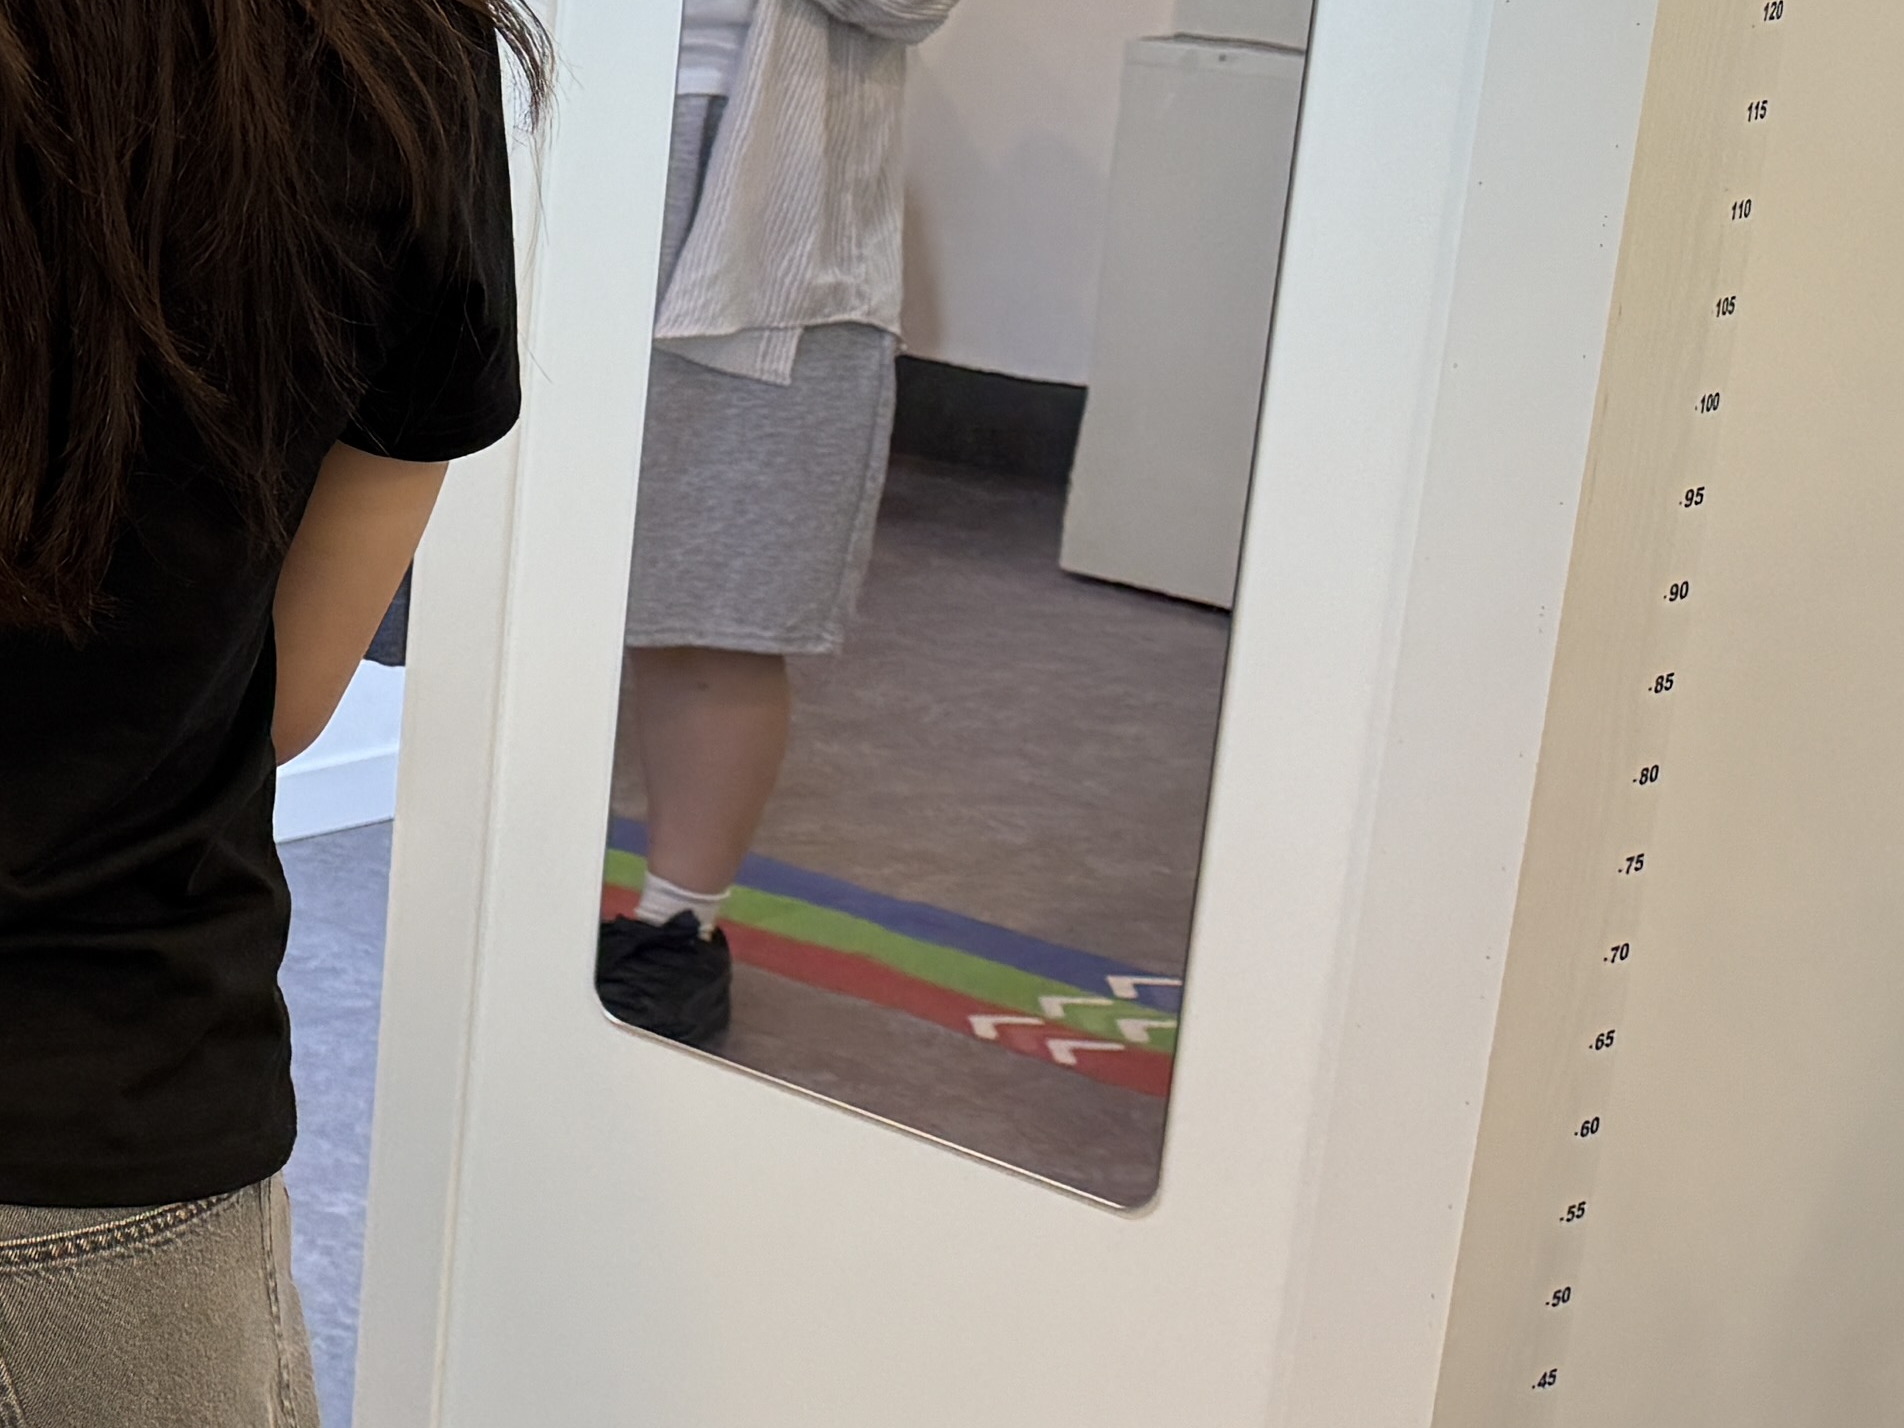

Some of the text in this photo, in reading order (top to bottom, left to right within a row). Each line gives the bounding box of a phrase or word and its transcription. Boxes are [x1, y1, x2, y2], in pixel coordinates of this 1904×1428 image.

[1763, 0, 1784, 22] 120
[1747, 99, 1769, 123] 115
[1731, 198, 1752, 221] 110
[1715, 295, 1737, 318] 105
[1700, 391, 1721, 414] 100
[1684, 485, 1706, 509] 95
[1669, 580, 1690, 603] 90
[1653, 671, 1675, 694] 85
[1638, 764, 1660, 786] 80
[1623, 852, 1645, 876] 75
[1609, 942, 1630, 964] 70
[1594, 1029, 1616, 1051] 65
[1579, 1116, 1601, 1138] 60
[1565, 1200, 1587, 1223] 55
[1551, 1285, 1572, 1308] 50
[1537, 1367, 1558, 1390] 45
